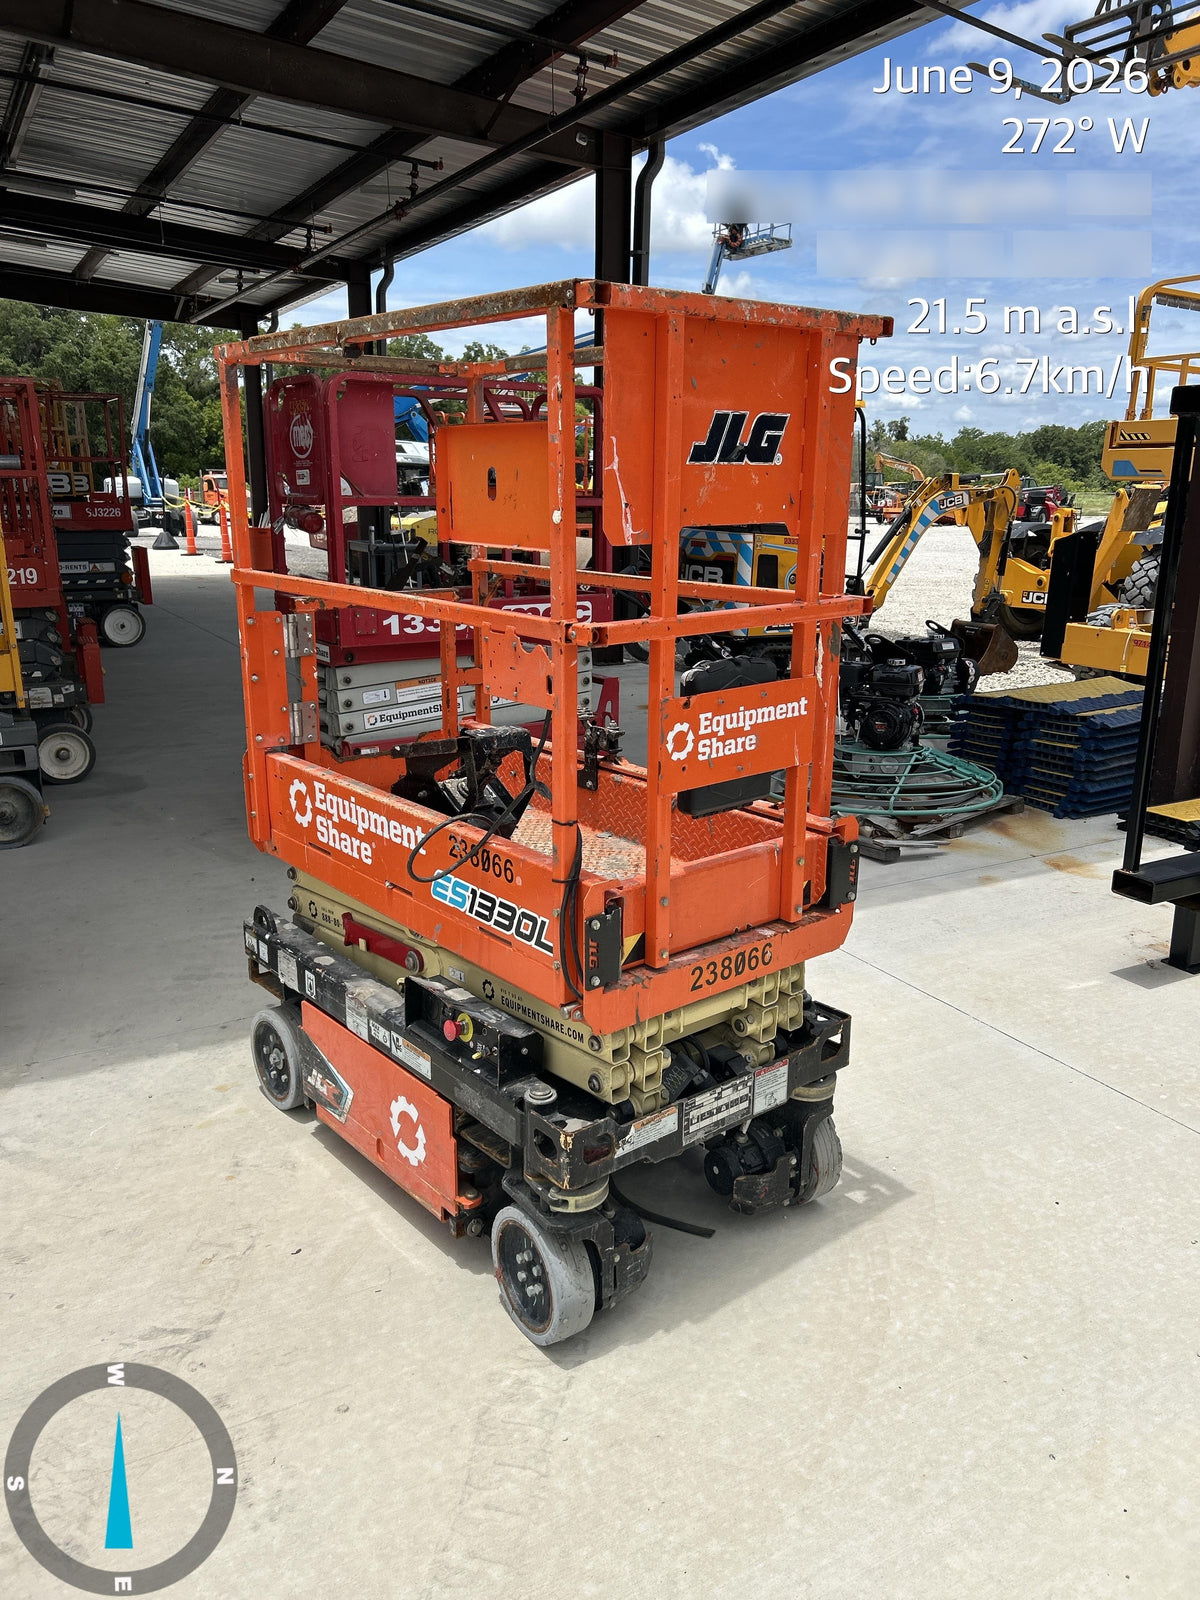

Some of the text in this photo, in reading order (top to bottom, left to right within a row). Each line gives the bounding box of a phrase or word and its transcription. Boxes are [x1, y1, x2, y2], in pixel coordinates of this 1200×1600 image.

[686, 410, 790, 465] JLG
[85, 507, 121, 518] SJ3226
[939, 494, 963, 510] JCB
[1022, 591, 1048, 605] JC
[698, 697, 809, 736] Equipment
[697, 734, 758, 761] Share
[313, 780, 427, 856] Equipment
[315, 814, 374, 865] Share
[448, 834, 515, 884] 238066
[431, 869, 553, 957] ES1330L
[589, 937, 599, 969] JLG
[690, 942, 773, 992] 238066
[501, 995, 584, 1043] EQUIPMENTSHARE.COM
